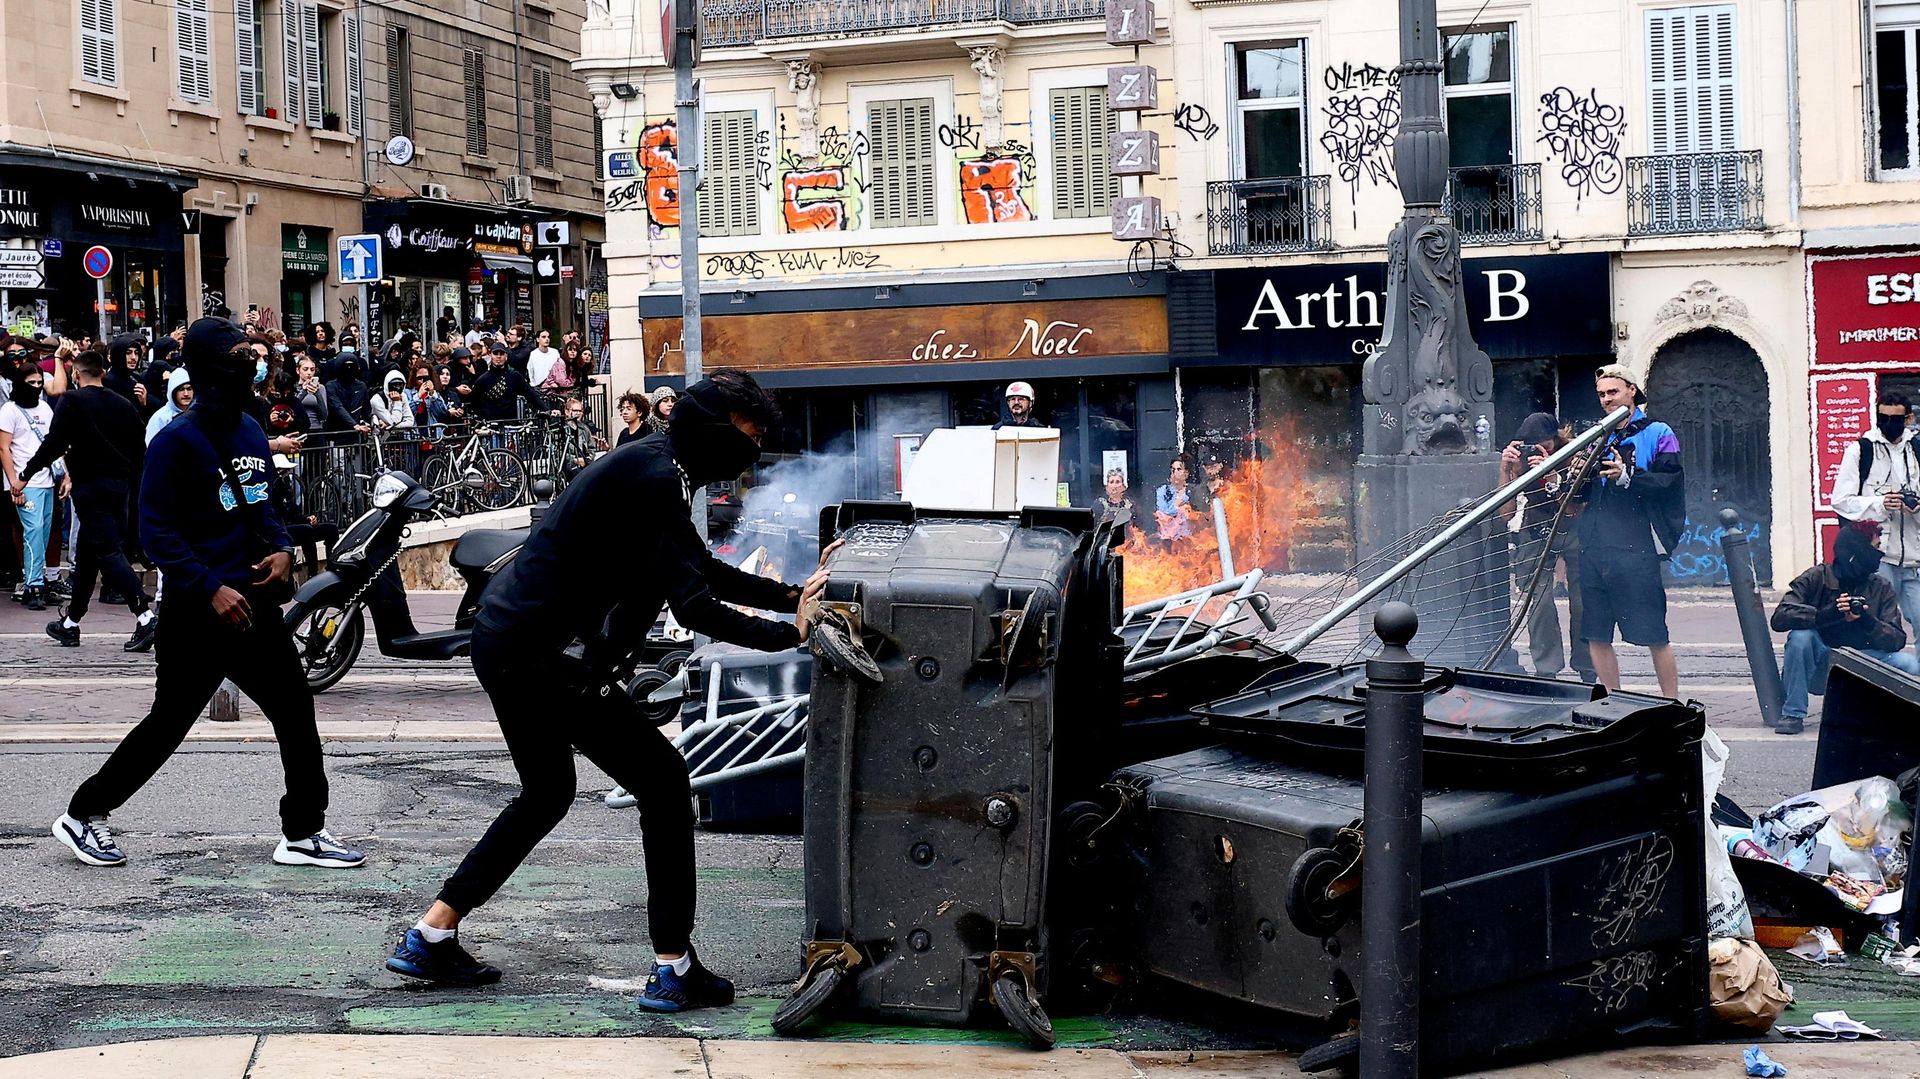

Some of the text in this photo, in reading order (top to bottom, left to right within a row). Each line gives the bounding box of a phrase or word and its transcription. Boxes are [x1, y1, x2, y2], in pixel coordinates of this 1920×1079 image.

[81, 204, 150, 227] VAPORISSIMA
[182, 212, 195, 230] V
[1241, 269, 1530, 330] Arth B
[911, 329, 977, 361] chez
[1839, 326, 1920, 344] IMPRIMER
[218, 455, 266, 480] LCOSTE
